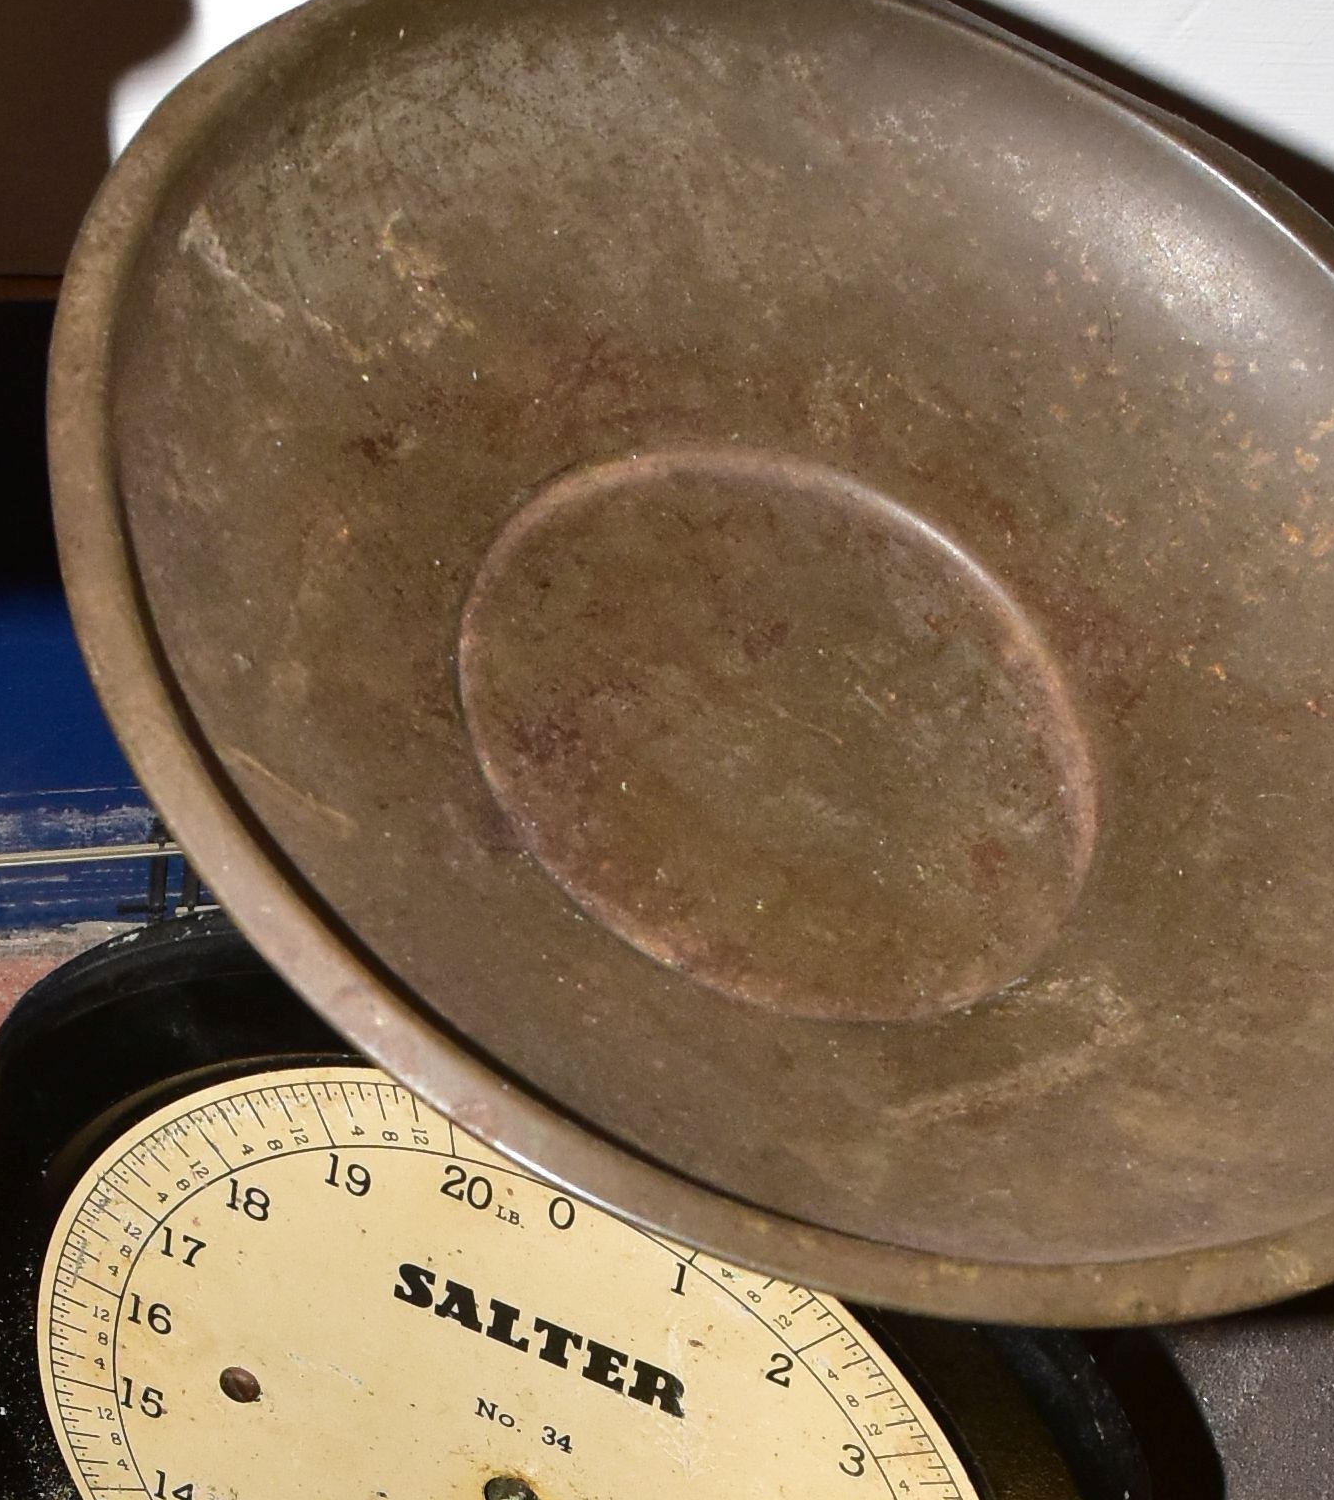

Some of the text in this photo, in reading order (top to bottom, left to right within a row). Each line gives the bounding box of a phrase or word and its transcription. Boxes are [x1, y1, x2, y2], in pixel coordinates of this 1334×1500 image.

[289, 1126, 309, 1145] 12
[351, 1125, 365, 1137] 4
[382, 1130, 399, 1142] 8
[411, 1127, 430, 1146] 12
[241, 1144, 255, 1156] 4
[267, 1139, 283, 1151] 8
[189, 1160, 210, 1180] 12
[324, 1153, 371, 1197] 19
[176, 1178, 190, 1191] 8
[440, 1164, 493, 1210] 20
[157, 1192, 169, 1204] 4
[226, 1178, 270, 1221] 18
[549, 1196, 575, 1230] 0
[123, 1221, 143, 1240] 12
[119, 1245, 132, 1258] 8
[160, 1226, 207, 1267] 17
[108, 1265, 119, 1277] 4
[670, 1262, 687, 1296] 1
[746, 1290, 761, 1303] 8
[92, 1305, 110, 1322] 12
[127, 1292, 172, 1335] 16
[773, 1314, 793, 1330] 12
[97, 1332, 109, 1346] 8
[393, 1263, 685, 1419] SALTER
[94, 1357, 106, 1370] 4
[765, 1352, 794, 1388] 2
[827, 1368, 840, 1381] 4
[120, 1376, 164, 1419] 15
[845, 1394, 859, 1408] 8
[97, 1406, 115, 1421] 12
[474, 1397, 574, 1454] No. 34
[863, 1423, 883, 1436] 12
[111, 1432, 122, 1446] 8
[117, 1459, 130, 1471] 4
[838, 1444, 865, 1478] 3
[899, 1480, 910, 1492] 4
